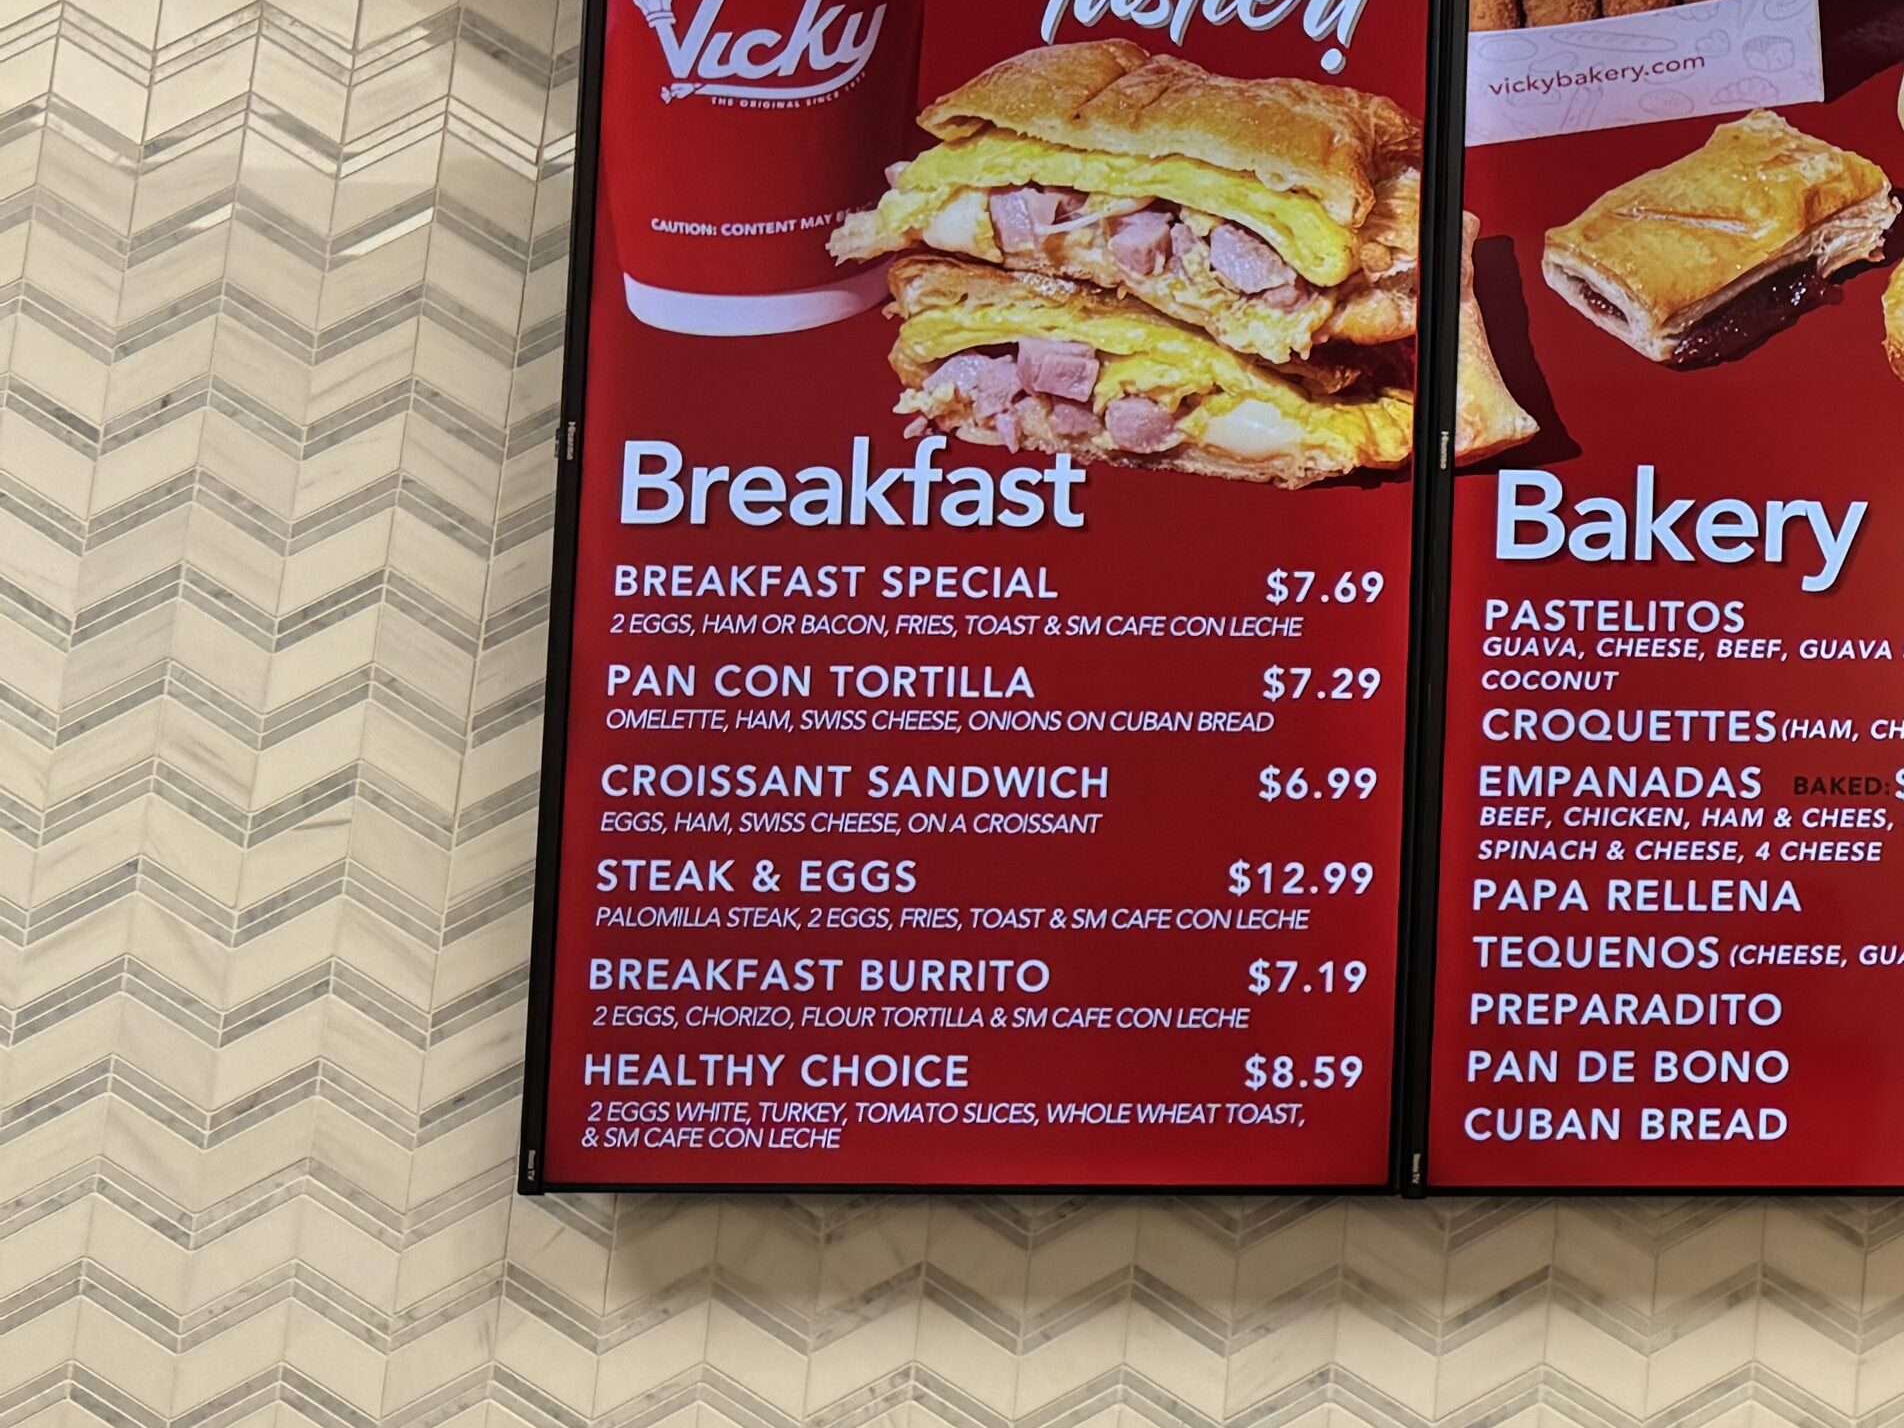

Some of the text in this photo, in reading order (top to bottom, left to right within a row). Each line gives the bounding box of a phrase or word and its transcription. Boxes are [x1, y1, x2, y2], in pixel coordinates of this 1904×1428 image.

[1489, 52, 1705, 96] vickybakery.com
[651, 218, 717, 236] CAUTION:
[721, 219, 796, 237] CONTENT
[800, 212, 832, 230] MAY
[621, 437, 1086, 527] Breakfast
[1496, 465, 1868, 591] Bakery
[615, 565, 1383, 605] BREAKFAST SPECIAL $7.69
[1486, 599, 1744, 633] PASTELITOS
[608, 665, 1380, 701] PAN CON TORTILLA $7.29
[1483, 709, 1776, 742] CROQUETTES
[1782, 719, 1858, 741] (HAM,
[602, 764, 1376, 802] CROISSANT SANDWICH $6.99
[1480, 766, 1761, 799] EMPANADAS
[1793, 776, 1891, 797] BAKED:
[601, 812, 1103, 836] EGGS, HAM, SWISS CHEESE, ON A CROISSANT
[597, 859, 1373, 896] STEAK & EGGS $12.99
[1474, 879, 1588, 911] PAPA
[1608, 880, 1801, 911] RELLENA
[590, 958, 1366, 995] BREAKFAST BURRITO $7.19
[1471, 993, 1781, 1025] PREPARADITO
[585, 1053, 1362, 1091] HEALTHY CHOICE $8.59
[1468, 1051, 1557, 1082] PAN
[1579, 1051, 1634, 1082] DE
[1655, 1050, 1788, 1083] BONO
[1465, 1108, 1620, 1140] CUBAN
[1641, 1108, 1787, 1140] BREAD
